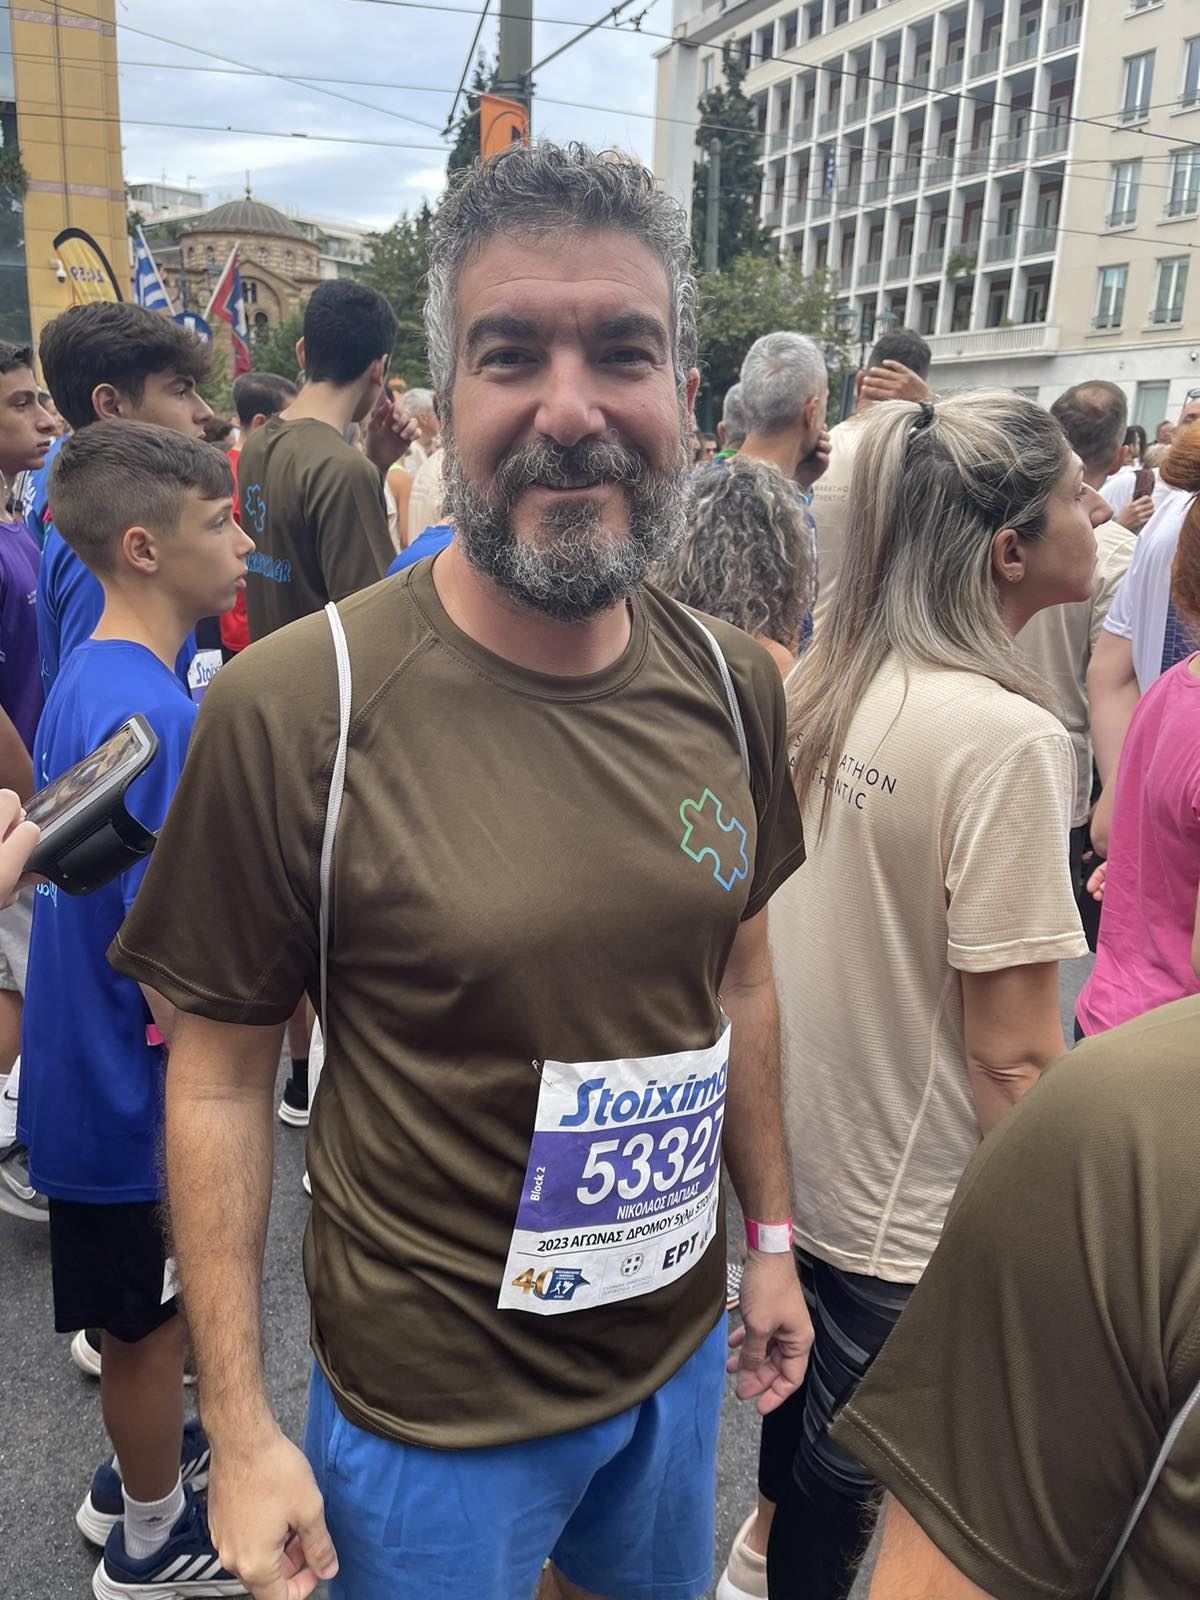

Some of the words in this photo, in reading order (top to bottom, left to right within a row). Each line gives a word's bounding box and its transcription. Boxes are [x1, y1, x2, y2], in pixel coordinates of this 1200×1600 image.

[810, 742, 897, 795] AATHON
[576, 1102, 725, 1205] 53327
[530, 1174, 545, 1201] Block
[617, 1195, 667, 1220] ΝΙΚΟΛΑΟΣ
[537, 1236, 569, 1252] 2023
[570, 1230, 624, 1248] ΑΓΩΝΑΣ
[625, 1215, 675, 1241] ΔΡΟΜΟΥ
[662, 1231, 699, 1270] ΕΡΤ
